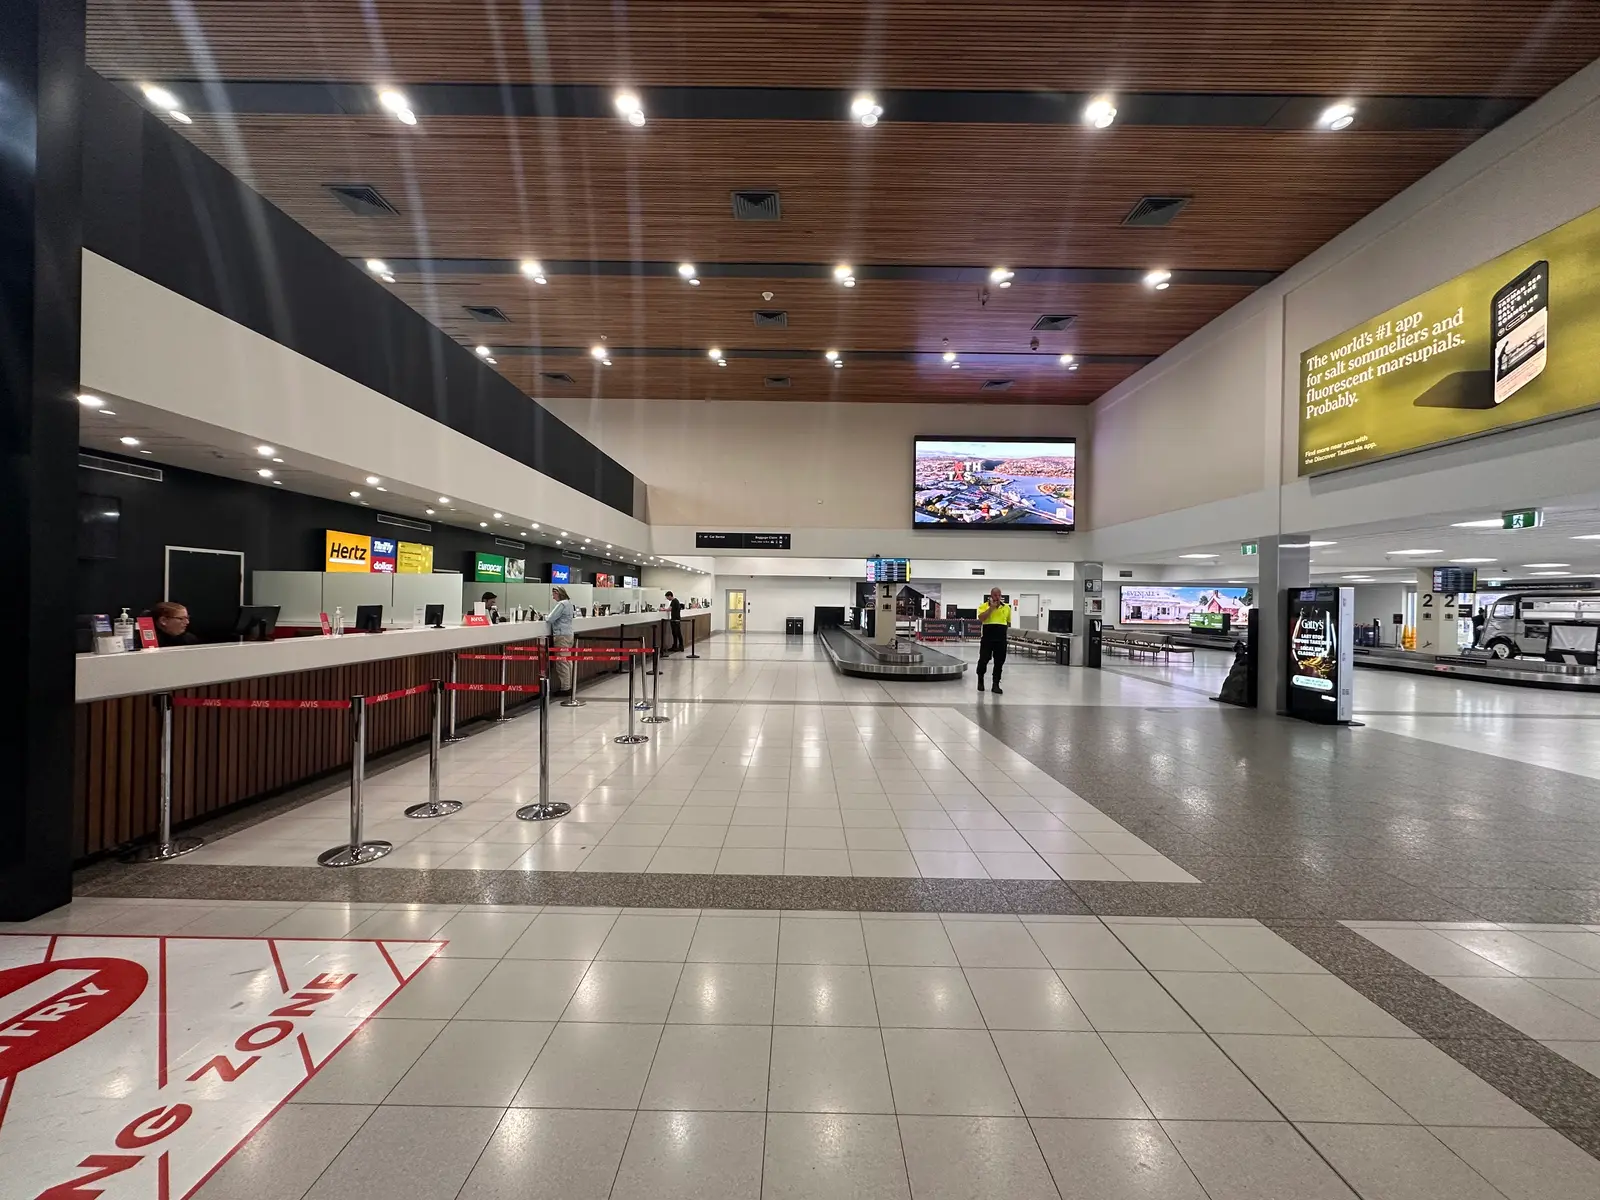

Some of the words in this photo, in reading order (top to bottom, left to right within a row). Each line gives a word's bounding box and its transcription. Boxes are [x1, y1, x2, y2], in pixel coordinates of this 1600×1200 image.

[1306, 355, 1328, 371] The
[1330, 332, 1373, 361] world's
[1376, 321, 1393, 341] #1
[1395, 311, 1423, 333] app
[1306, 373, 1323, 388] for
[1325, 361, 1346, 380] salt
[1348, 327, 1428, 371] sommeliers
[1432, 307, 1464, 336] and
[1306, 366, 1373, 403] fluorescent
[1377, 333, 1466, 377] marsupials.
[1306, 392, 1359, 419] Probably.
[1314, 452, 1337, 462] Discover
[1337, 445, 1363, 456] Tasmania
[1317, 446, 1330, 454] more
[1343, 440, 1355, 448] you
[1355, 435, 1369, 443] with
[330, 542, 367, 560] Hertz
[478, 561, 503, 572] Europcar
[882, 585, 892, 598] 1
[1423, 594, 1433, 607] 2
[1445, 594, 1455, 607] 2
[203, 699, 221, 707] AVIS
[251, 700, 269, 708] AVIS
[376, 693, 389, 702] AVIS
[405, 687, 416, 695] AVIS
[0, 982, 110, 1054] TRY
[187, 973, 358, 1082] ZONE
